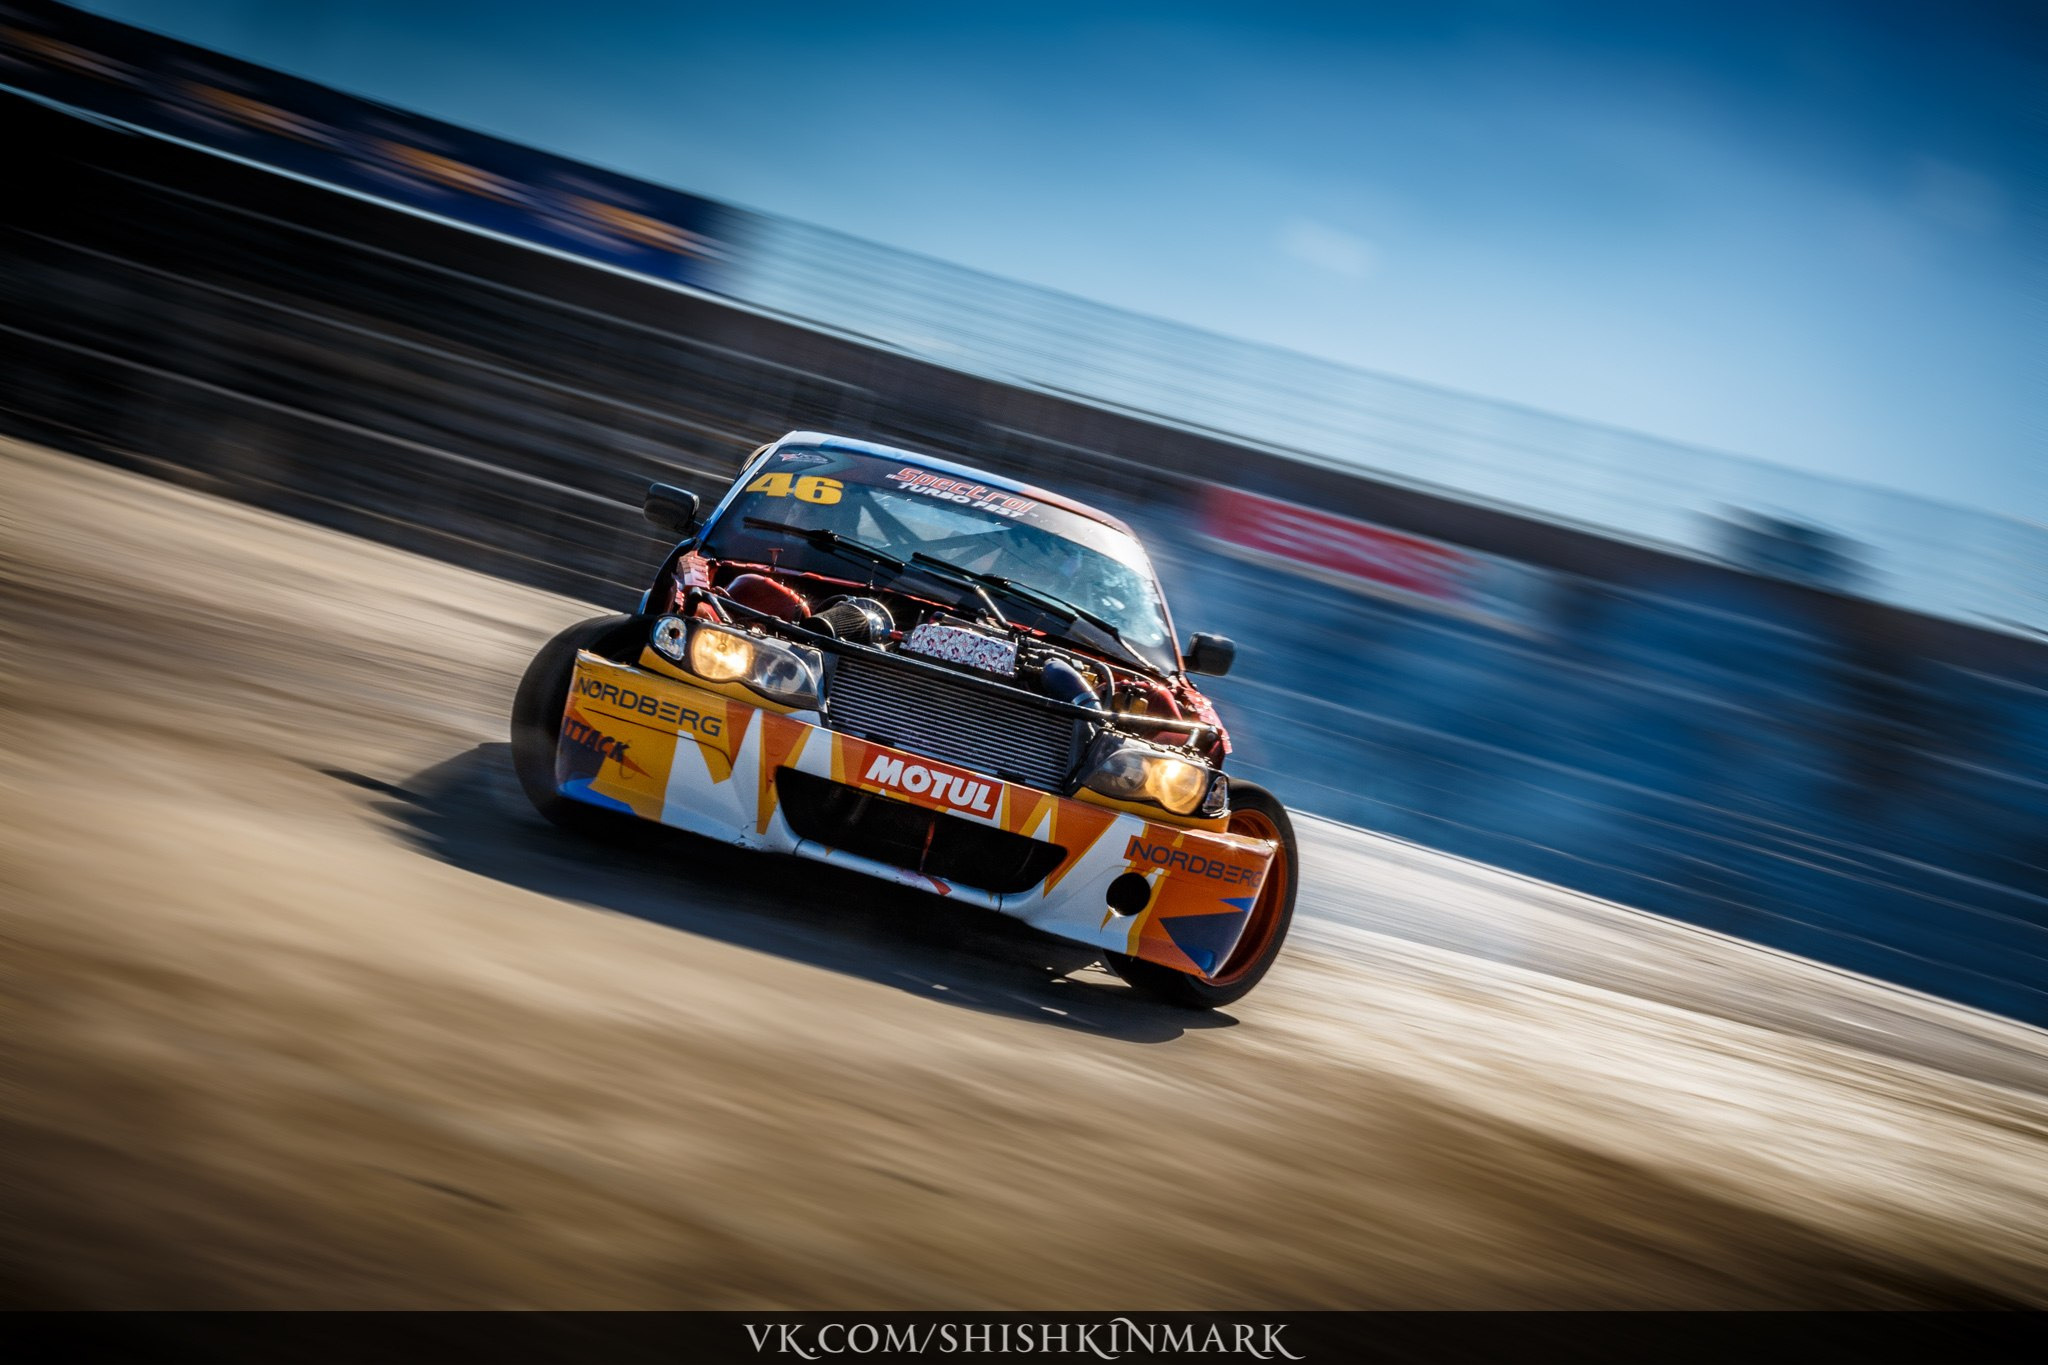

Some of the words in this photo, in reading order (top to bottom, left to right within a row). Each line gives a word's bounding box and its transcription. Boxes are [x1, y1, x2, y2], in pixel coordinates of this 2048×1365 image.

[746, 472, 844, 505] 46
[895, 467, 1038, 513] Spectrol
[898, 482, 971, 504] TURBO
[972, 500, 1024, 518] FEST
[575, 676, 722, 737] NORDBERG
[865, 754, 991, 813] MOTUL
[1129, 839, 1263, 888] NORDBERG
